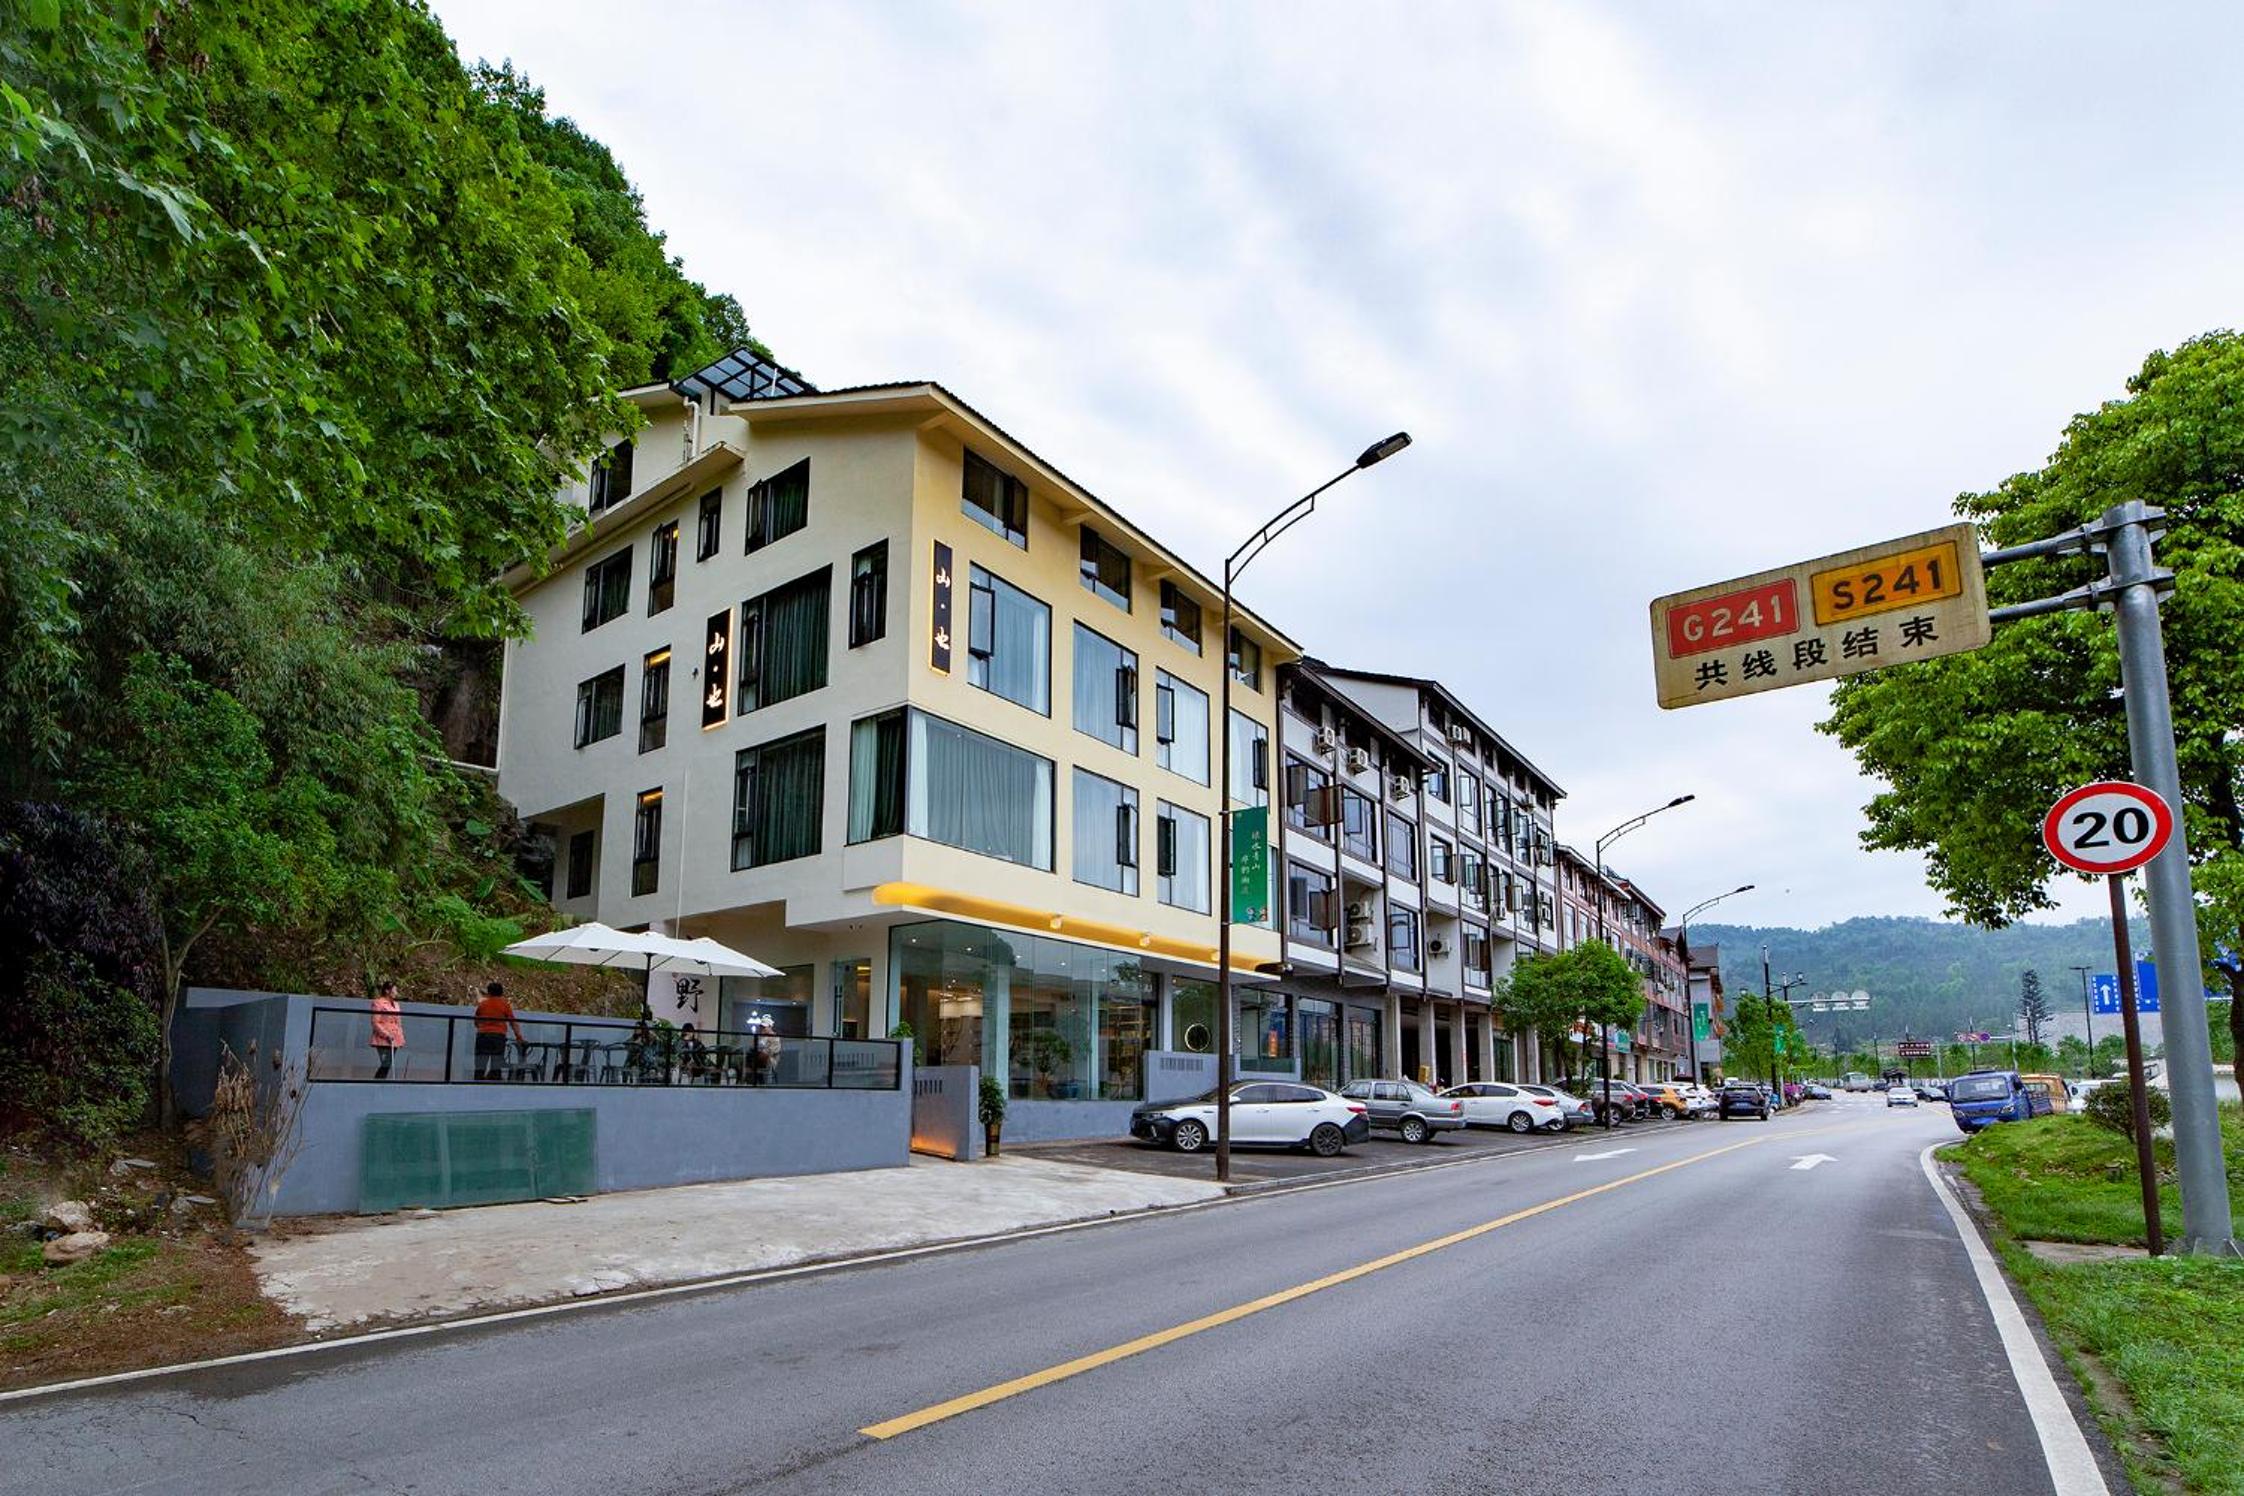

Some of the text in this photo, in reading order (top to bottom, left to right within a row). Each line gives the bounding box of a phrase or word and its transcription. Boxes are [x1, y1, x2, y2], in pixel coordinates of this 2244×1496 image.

[1683, 559, 1941, 641] G241 S241
[1695, 615, 1939, 690] 共线段结束
[2072, 807, 2149, 849] 20
[675, 977, 704, 1013] 野
